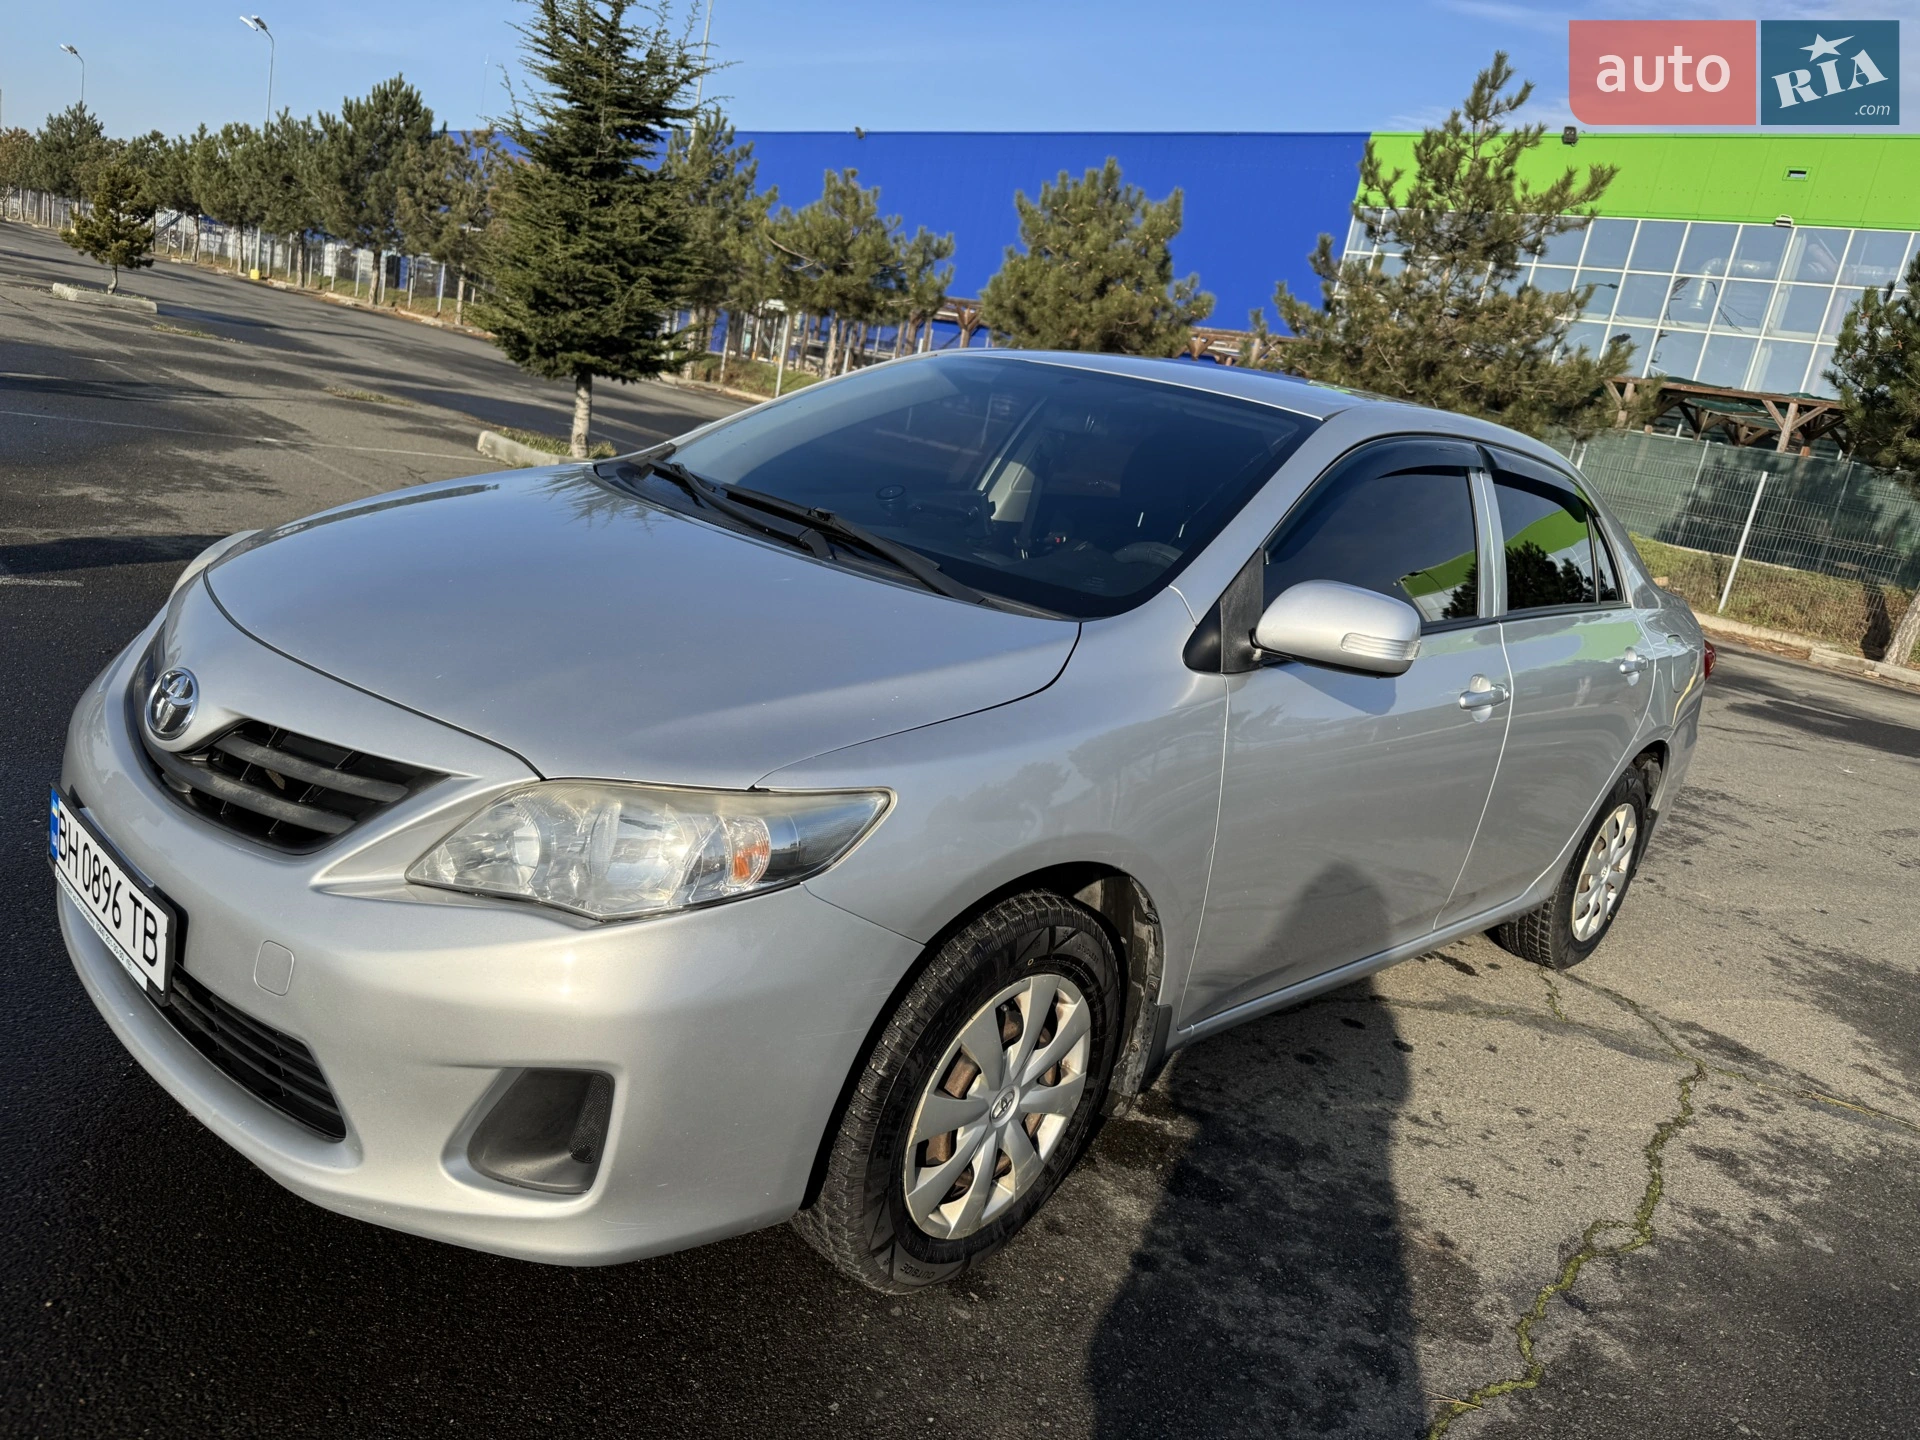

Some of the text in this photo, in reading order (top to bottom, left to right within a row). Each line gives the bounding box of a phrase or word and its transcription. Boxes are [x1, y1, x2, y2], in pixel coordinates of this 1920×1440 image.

[59, 812, 79, 880] BH
[82, 842, 122, 930] 0896
[128, 890, 158, 967] TB
[900, 1262, 935, 1279] OUTSIDE
